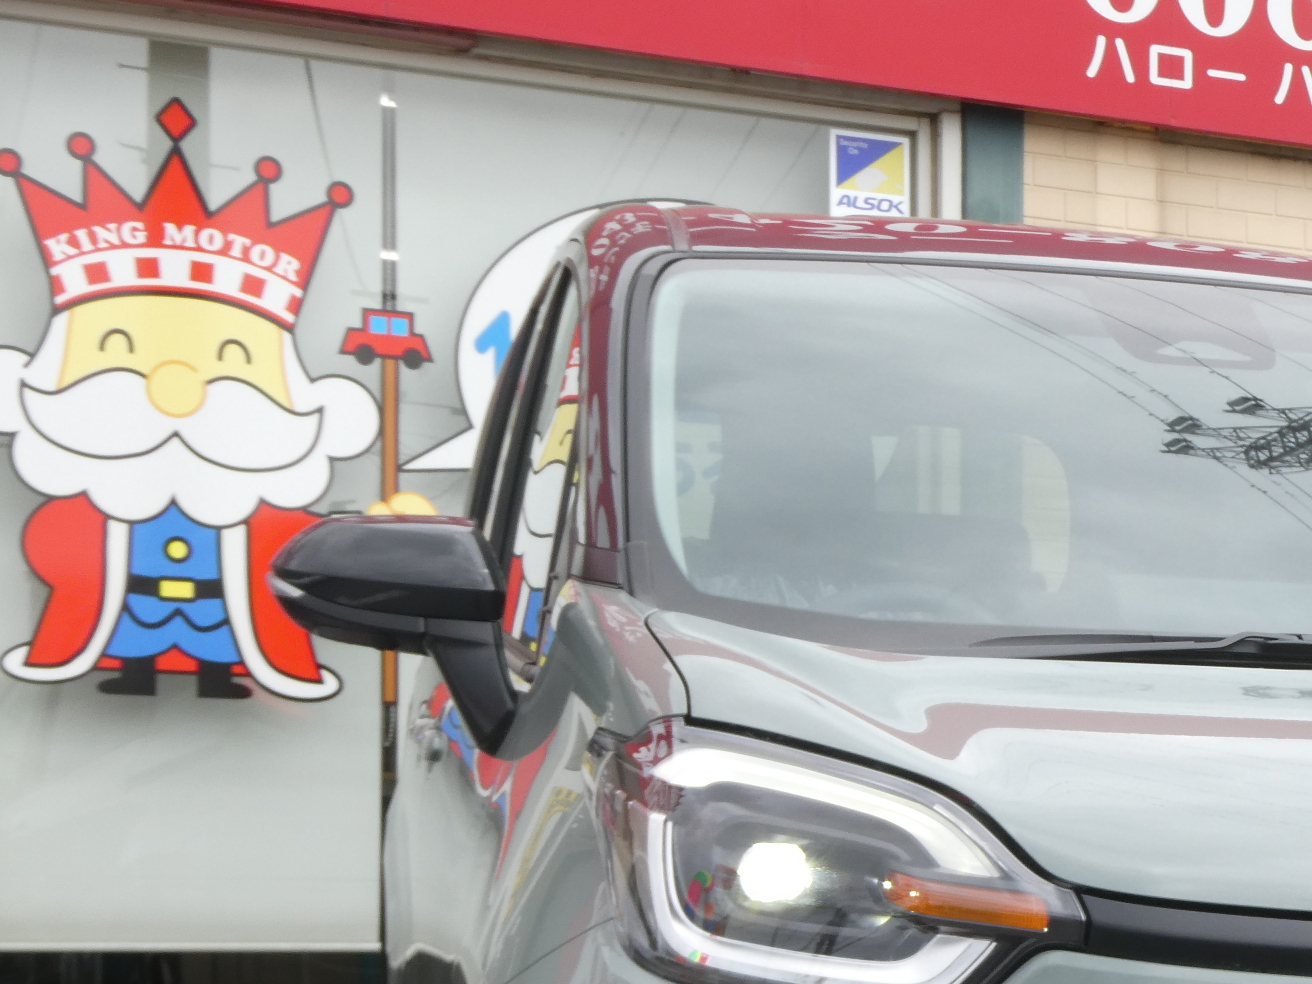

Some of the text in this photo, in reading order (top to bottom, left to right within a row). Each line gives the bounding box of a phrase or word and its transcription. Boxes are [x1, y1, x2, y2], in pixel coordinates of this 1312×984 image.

[1086, 35, 1247, 90] ハロー
[836, 194, 905, 215] ALSOK
[43, 221, 301, 283] KING MOTOR
